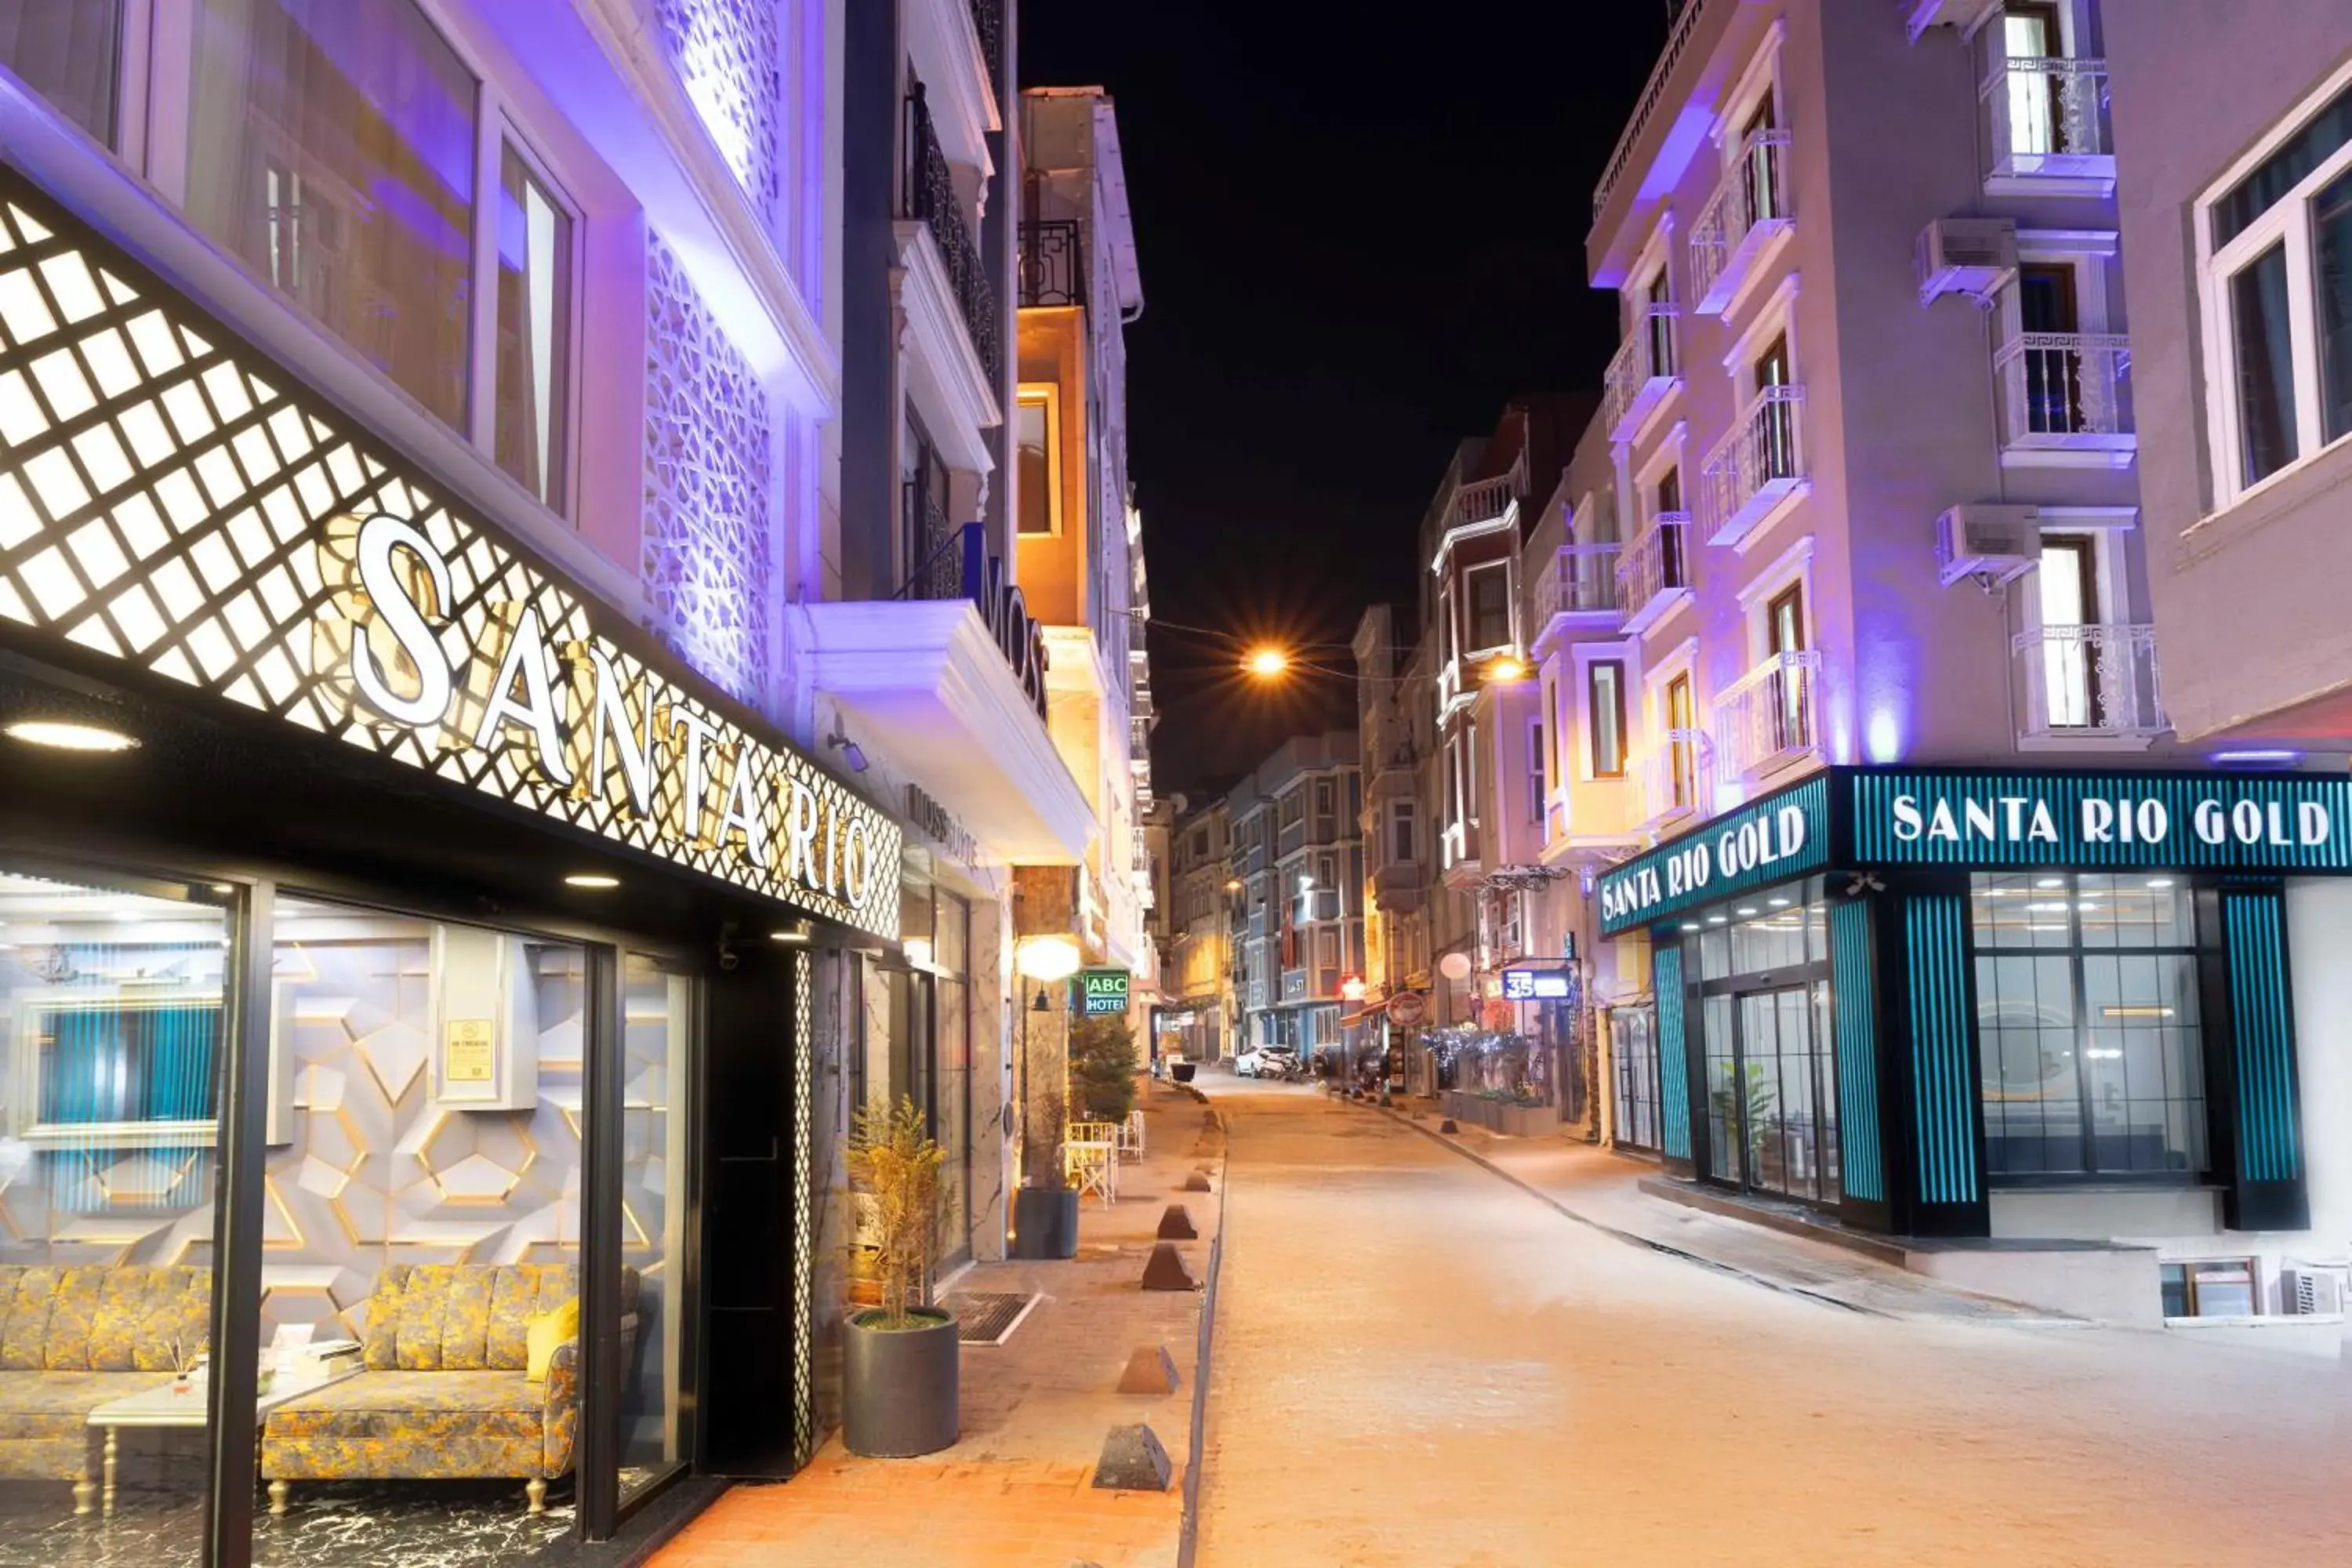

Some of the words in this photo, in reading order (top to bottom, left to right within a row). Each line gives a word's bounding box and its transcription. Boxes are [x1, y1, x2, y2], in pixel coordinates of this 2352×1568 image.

[350, 512, 766, 868] SANTA
[790, 772, 873, 911] RIO
[1893, 795, 2059, 841] SANTA
[2082, 798, 2168, 844] RIO
[2194, 798, 2330, 846] GOLD
[1602, 865, 1661, 921] SANTA
[1668, 843, 1710, 897] RIO
[1719, 805, 1805, 877] GOLD
[1088, 1000, 1124, 1011] HOTEL
[1089, 978, 1126, 992] ABC
